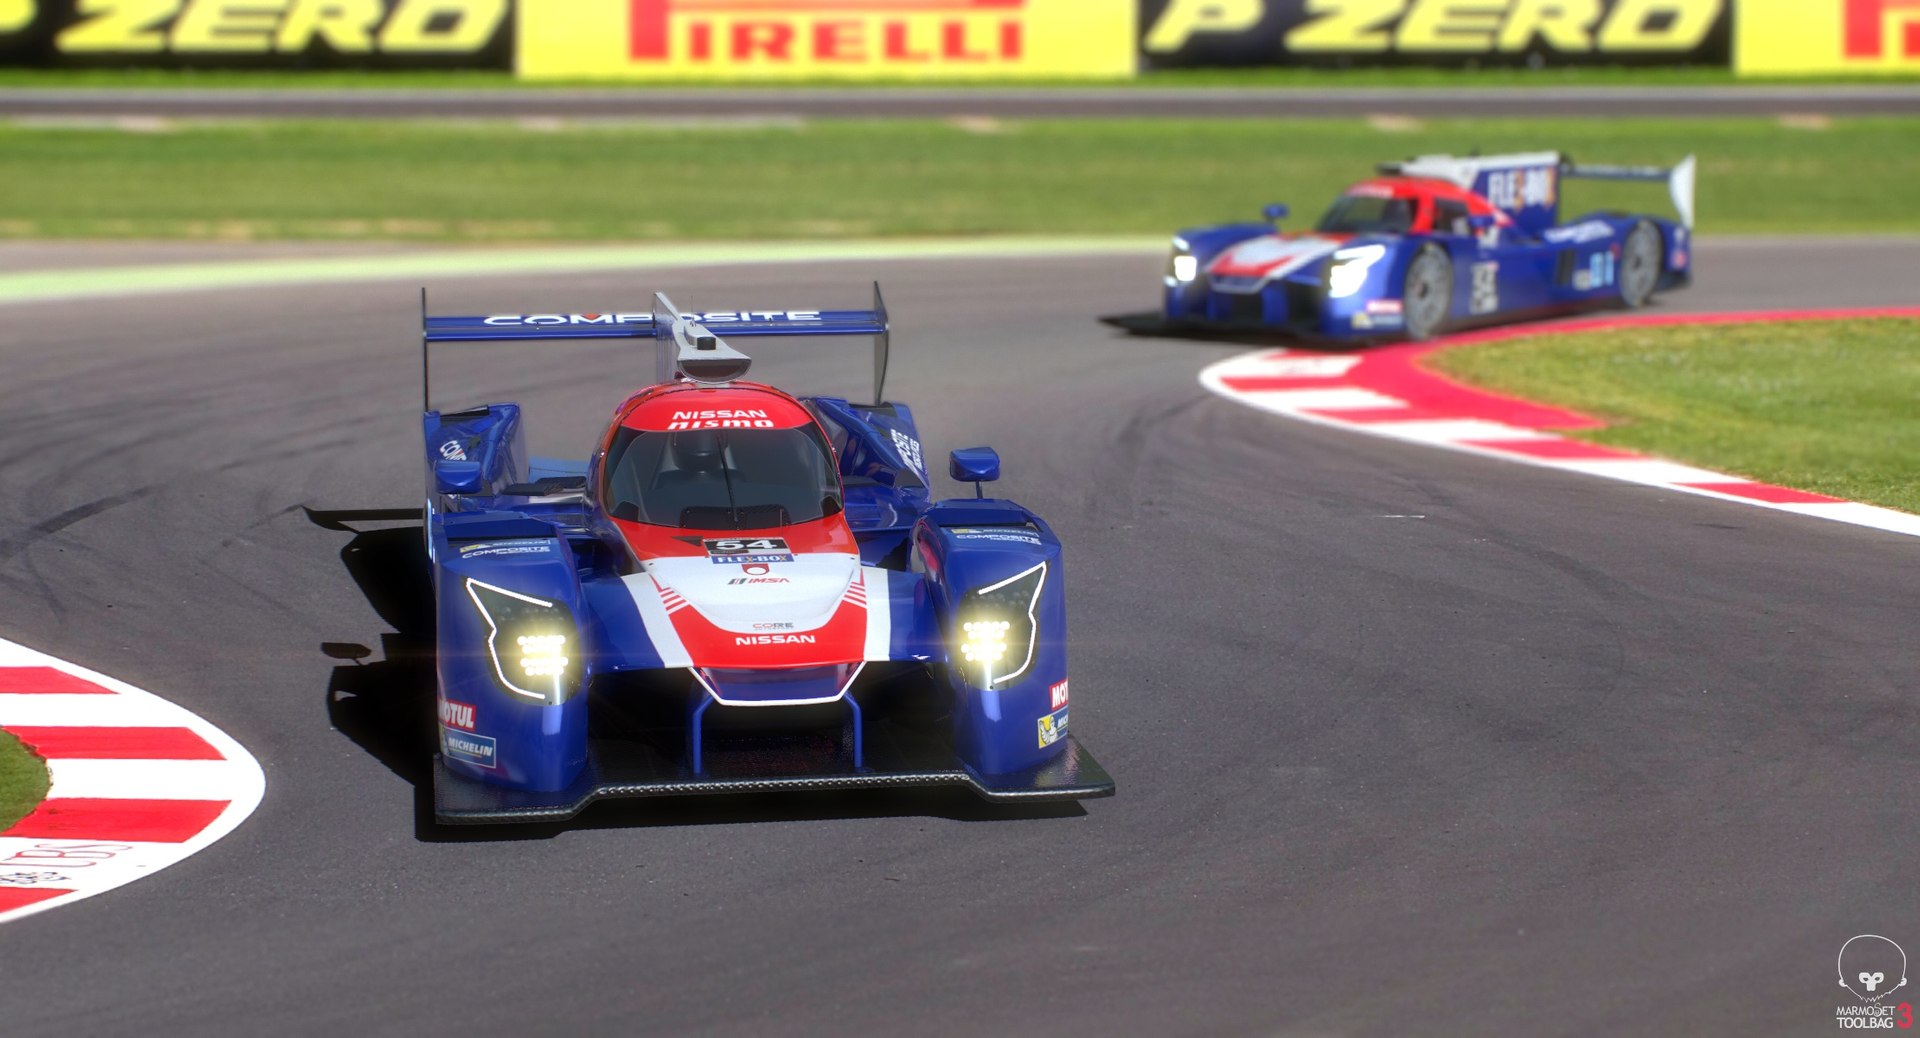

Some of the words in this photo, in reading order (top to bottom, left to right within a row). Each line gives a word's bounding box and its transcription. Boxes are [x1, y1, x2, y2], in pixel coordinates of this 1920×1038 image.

[57, 0, 503, 52] ZERO
[628, 0, 1025, 61] PIRELLI
[1284, 0, 1725, 50] ZERO
[672, 409, 768, 420] NISSAN
[716, 539, 777, 550] 54
[717, 555, 787, 563] FLEX-BOX
[735, 635, 816, 646] NISSAN
[1052, 681, 1069, 708] MOT
[447, 737, 493, 757] MICHELIN
